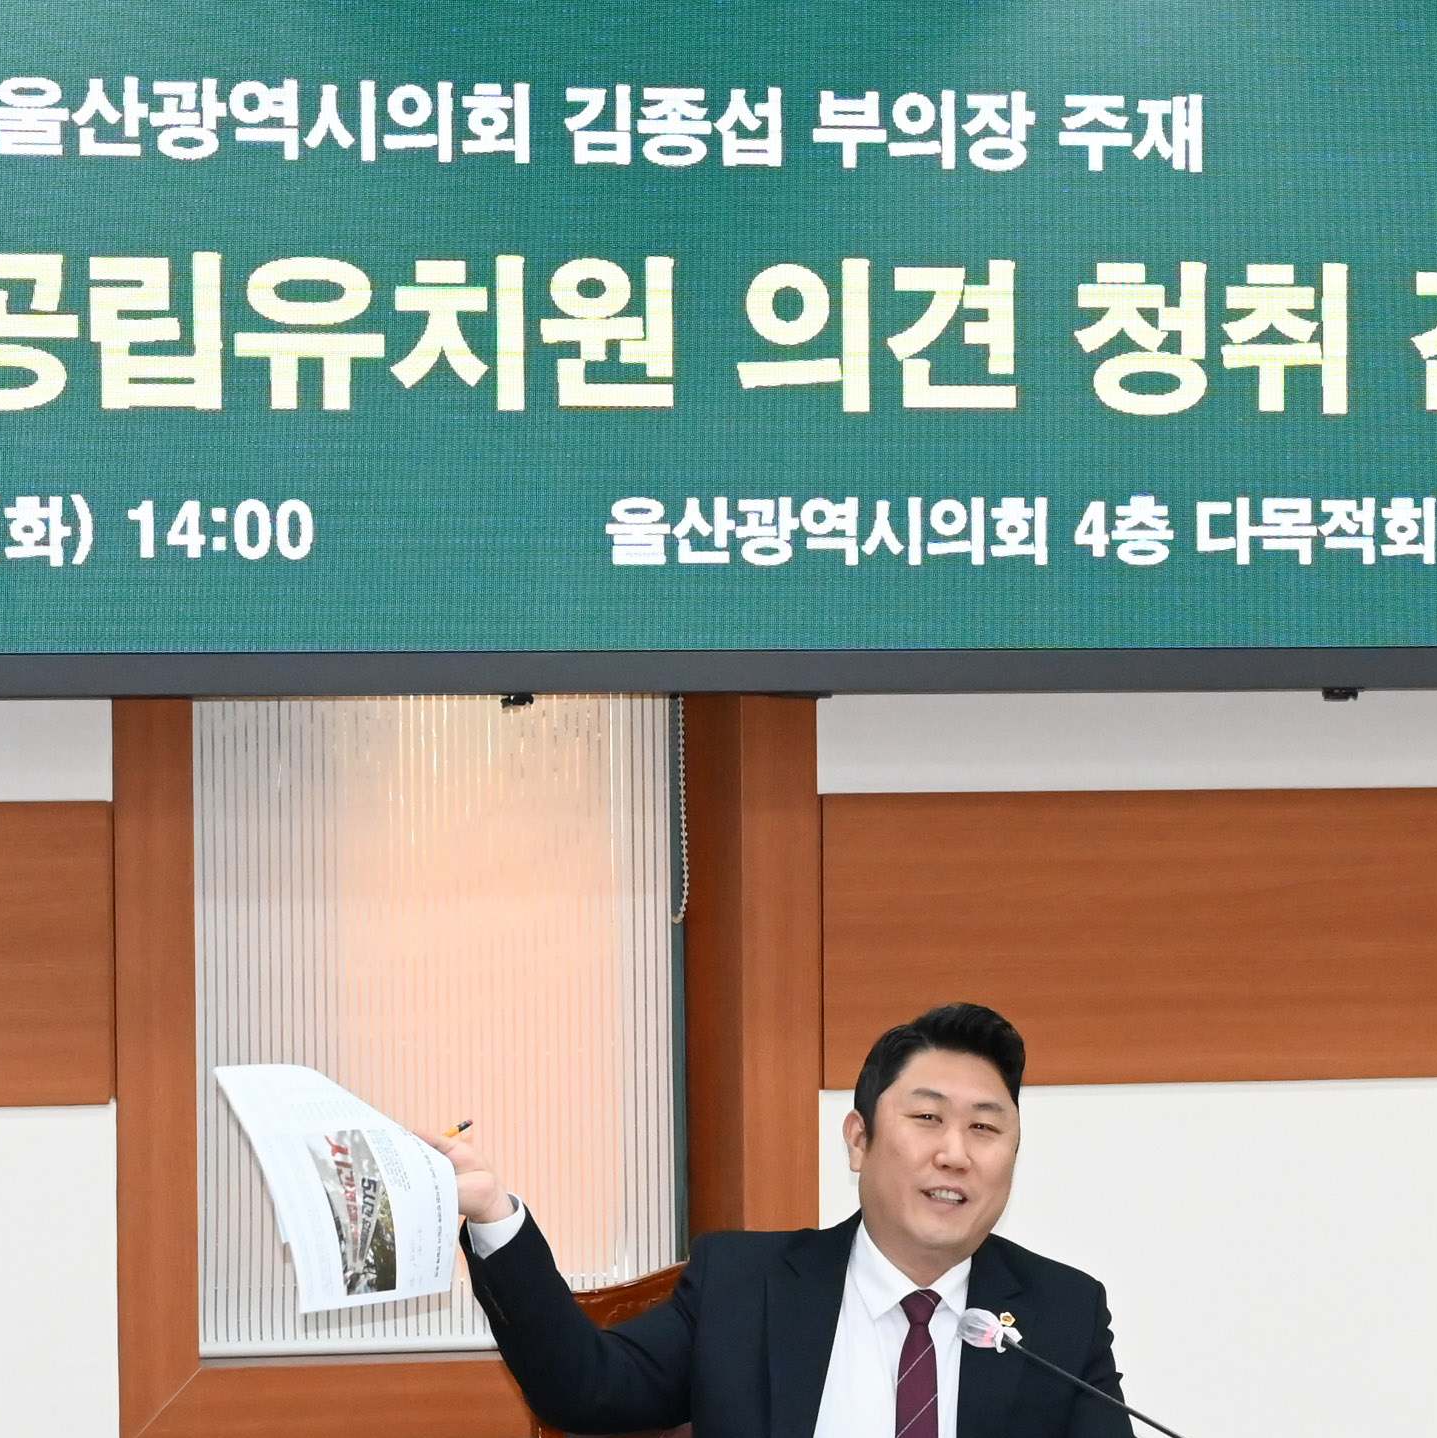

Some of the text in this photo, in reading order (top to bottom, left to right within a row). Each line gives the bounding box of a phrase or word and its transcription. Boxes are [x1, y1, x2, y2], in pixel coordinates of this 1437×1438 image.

[565, 84, 782, 166] 김종섭
[813, 90, 1035, 171] 부의장
[1059, 94, 1204, 172] 주재
[737, 258, 1016, 412] 의견
[1074, 262, 1349, 415] 청취
[128, 499, 314, 560] 14:00
[606, 497, 1047, 566] 울산광역시의회
[1075, 496, 1174, 565] 4층
